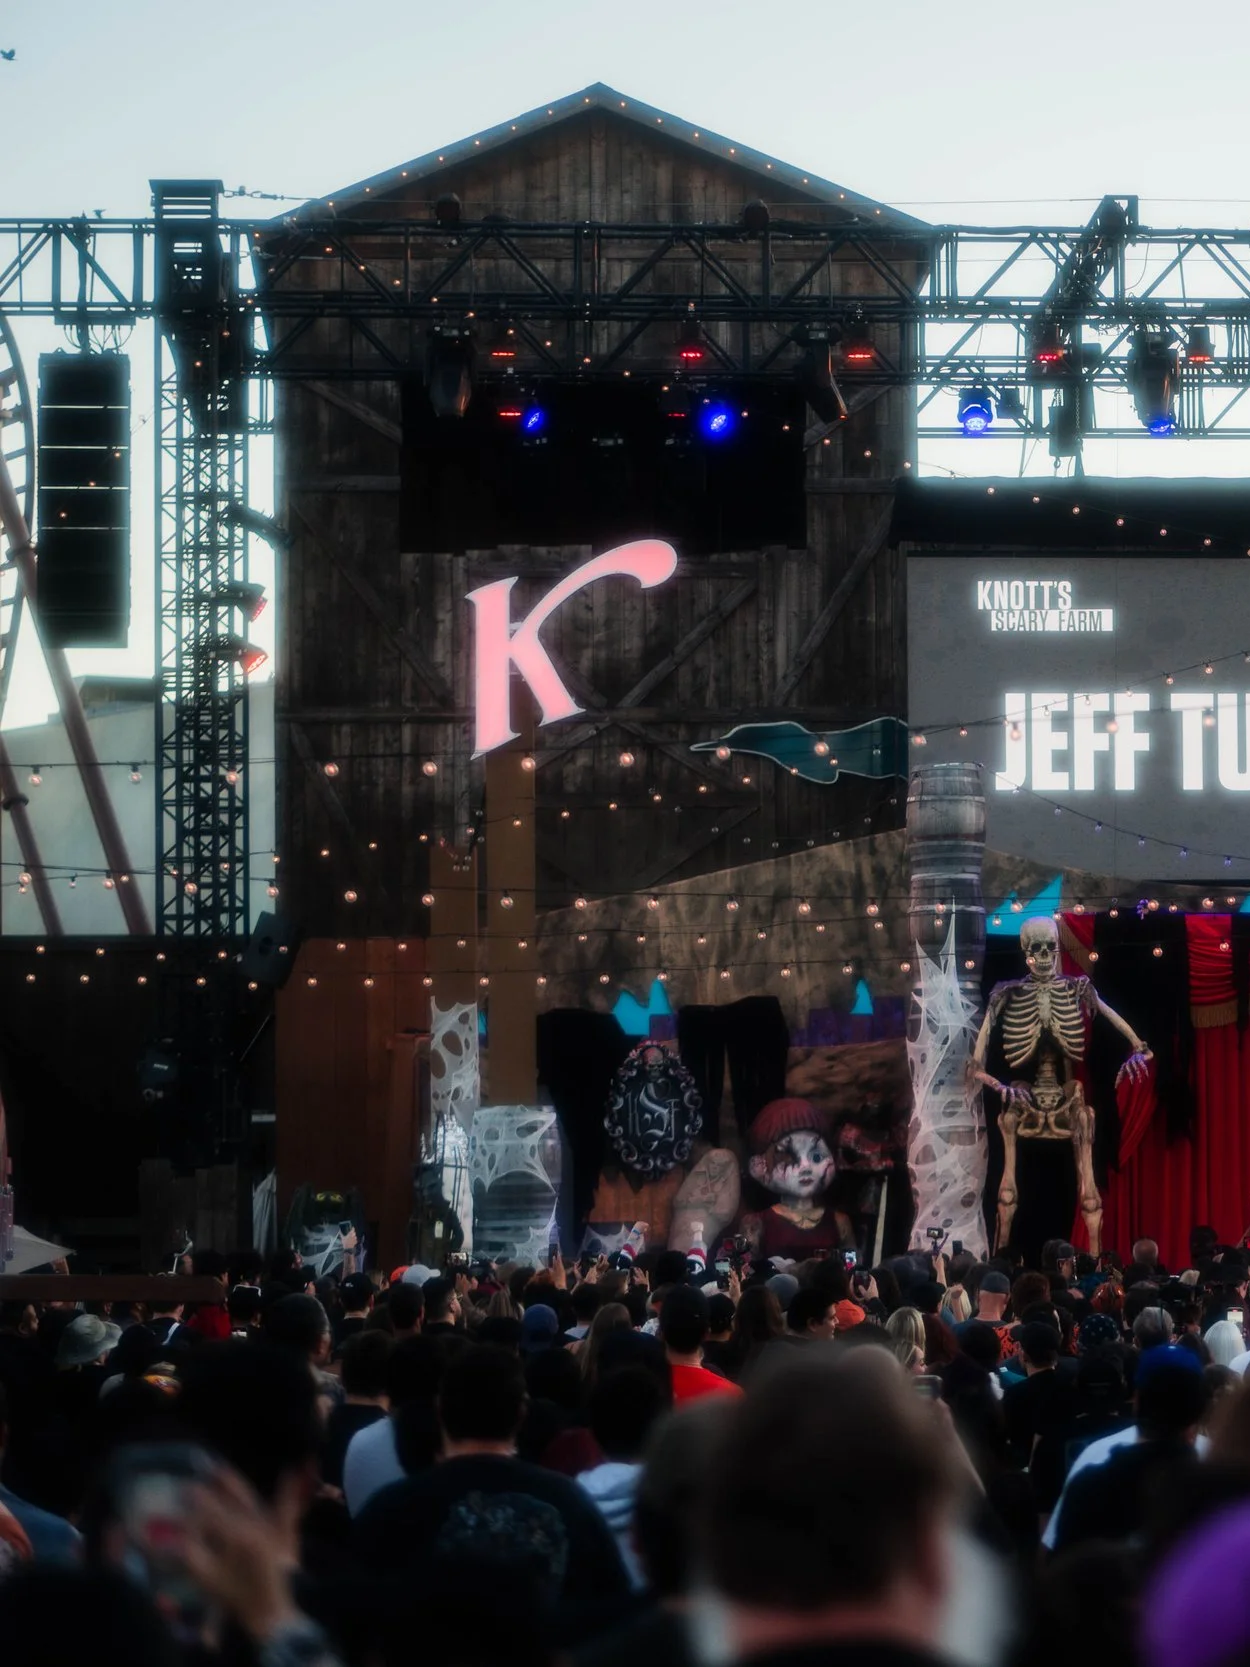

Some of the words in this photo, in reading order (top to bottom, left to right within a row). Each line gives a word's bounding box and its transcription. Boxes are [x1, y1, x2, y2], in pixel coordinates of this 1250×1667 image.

[977, 580, 1072, 610] KNOTT'S
[995, 610, 1048, 632] SCARY
[1058, 610, 1103, 632] FARM
[464, 539, 678, 760] K
[995, 693, 1151, 790] JEFF
